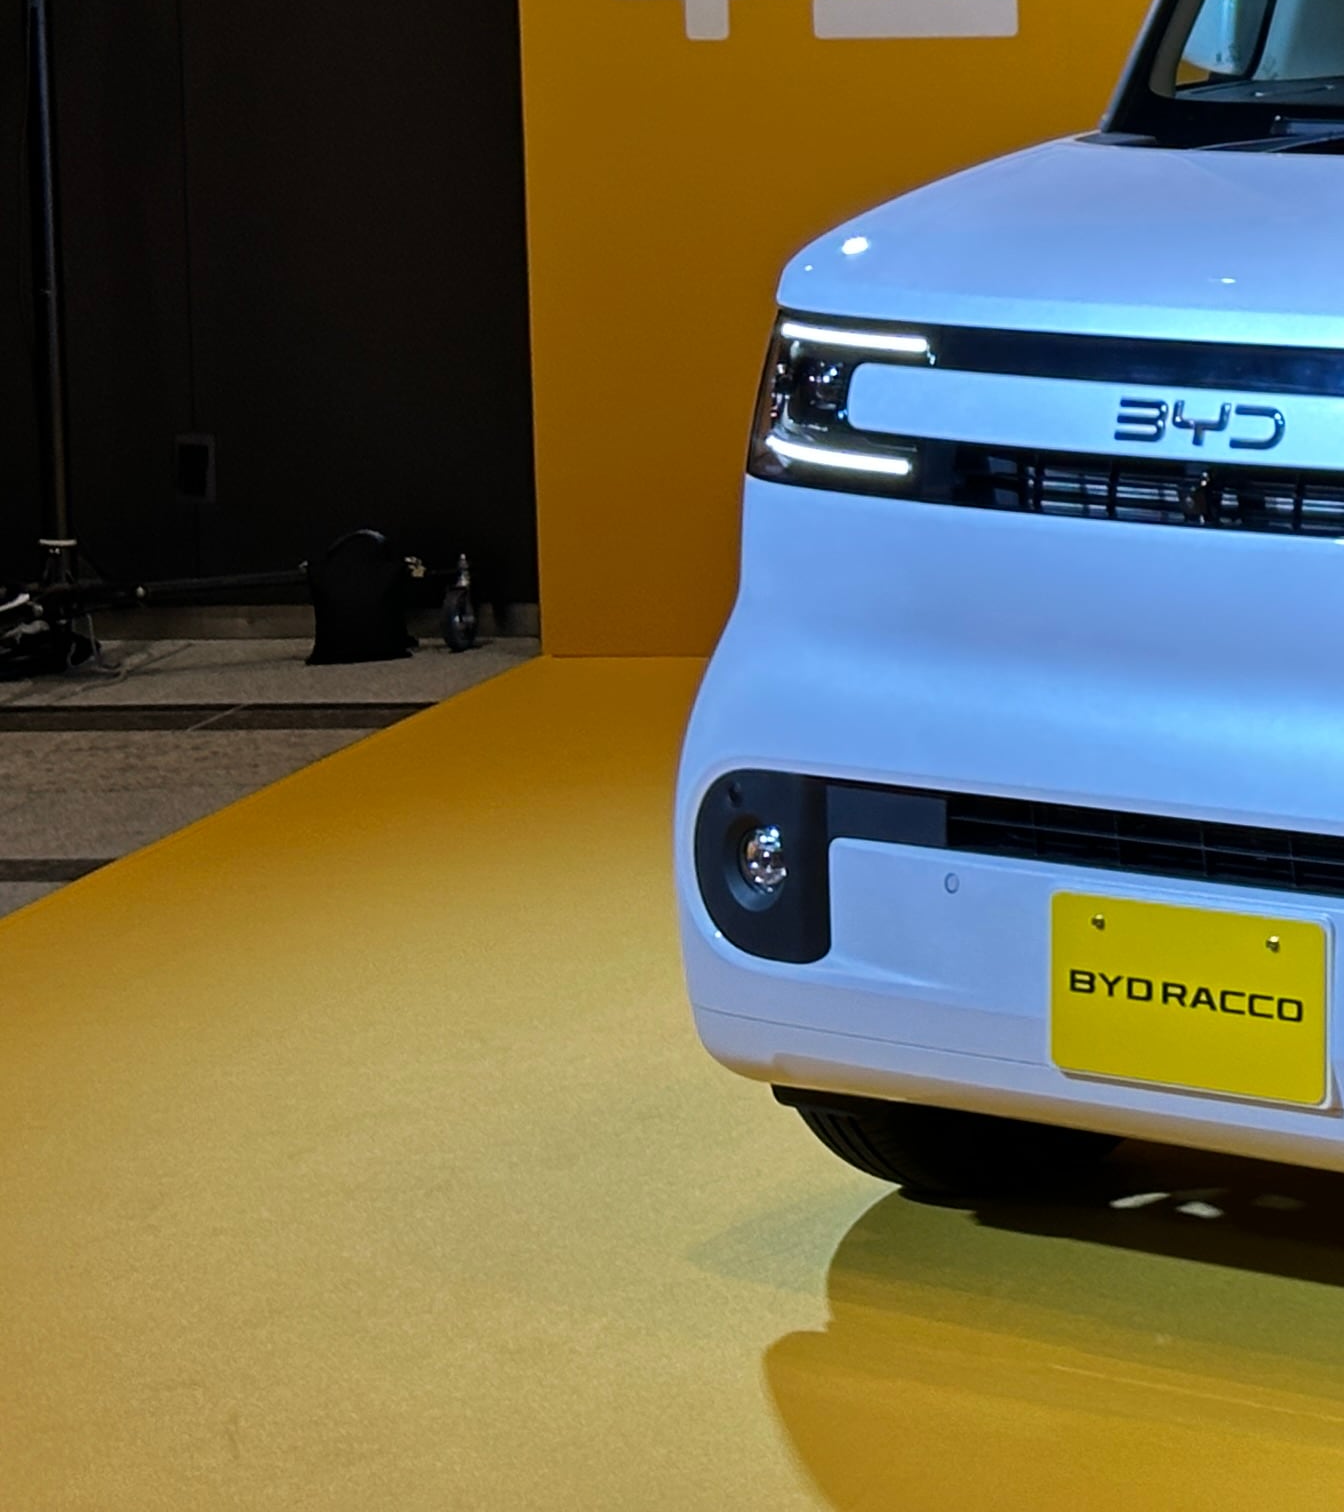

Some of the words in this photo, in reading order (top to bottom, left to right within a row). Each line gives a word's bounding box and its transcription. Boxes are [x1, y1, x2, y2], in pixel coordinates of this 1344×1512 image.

[1114, 398, 1286, 450] BYD
[1069, 969, 1154, 1002] BYD
[1161, 981, 1304, 1023] RACCO
